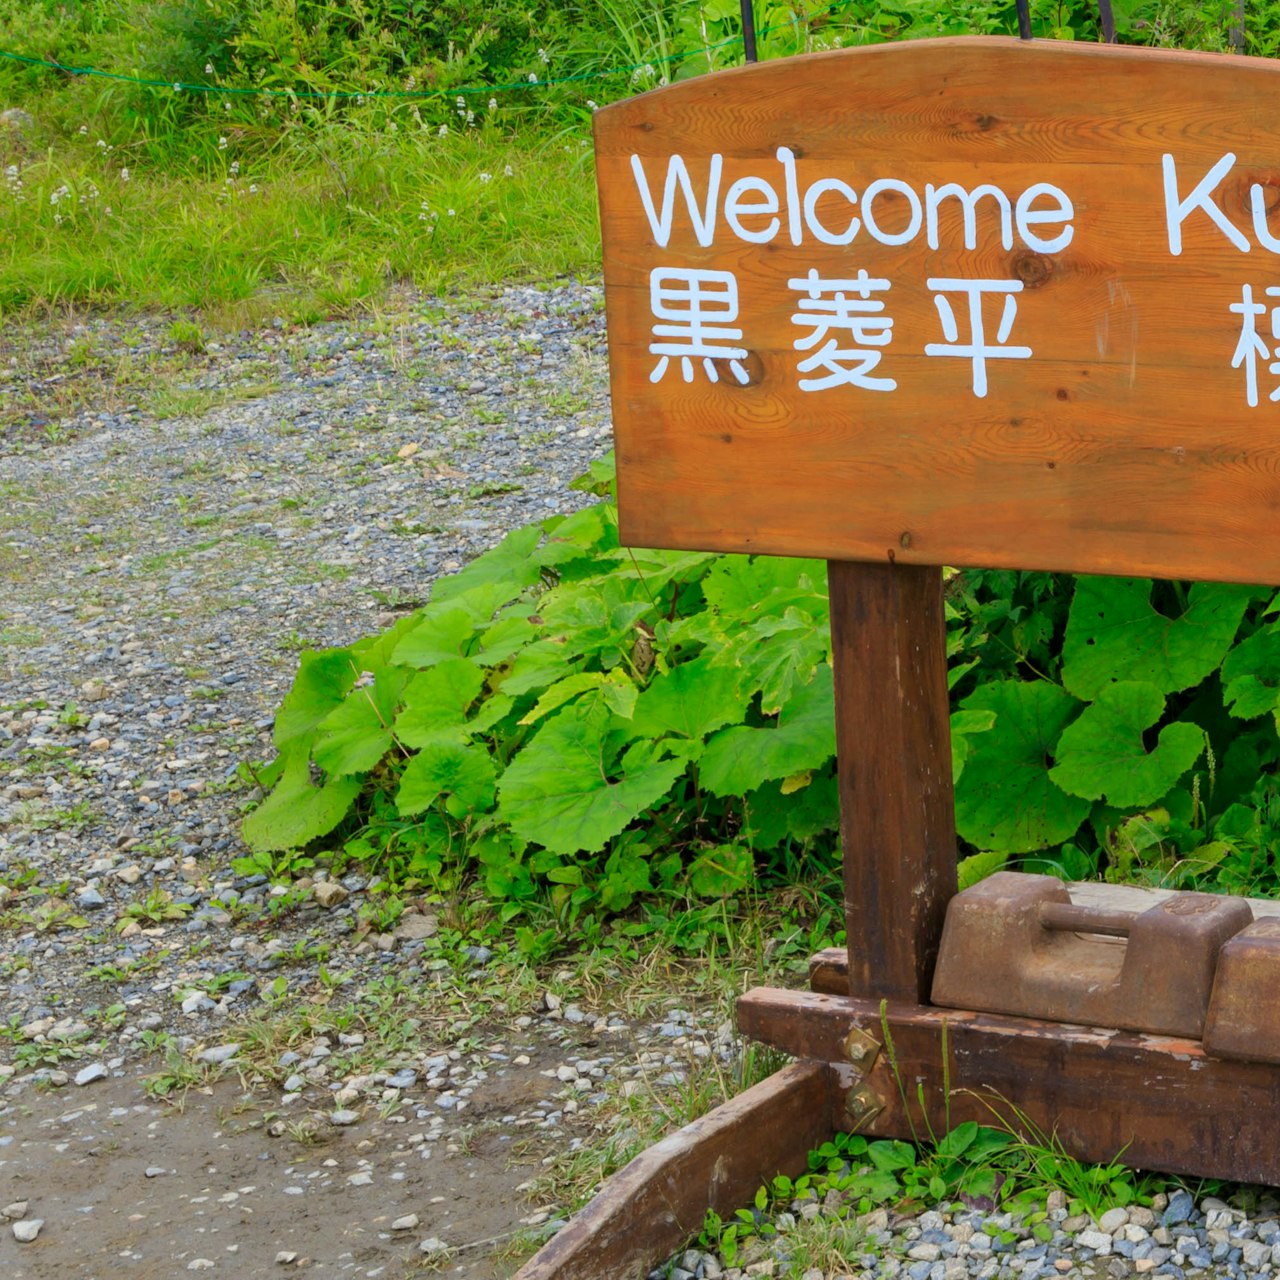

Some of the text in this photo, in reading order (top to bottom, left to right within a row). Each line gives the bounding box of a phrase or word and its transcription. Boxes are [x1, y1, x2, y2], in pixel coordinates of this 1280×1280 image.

[631, 147, 1074, 254] Welcome
[648, 267, 1033, 398] 黒菱平
